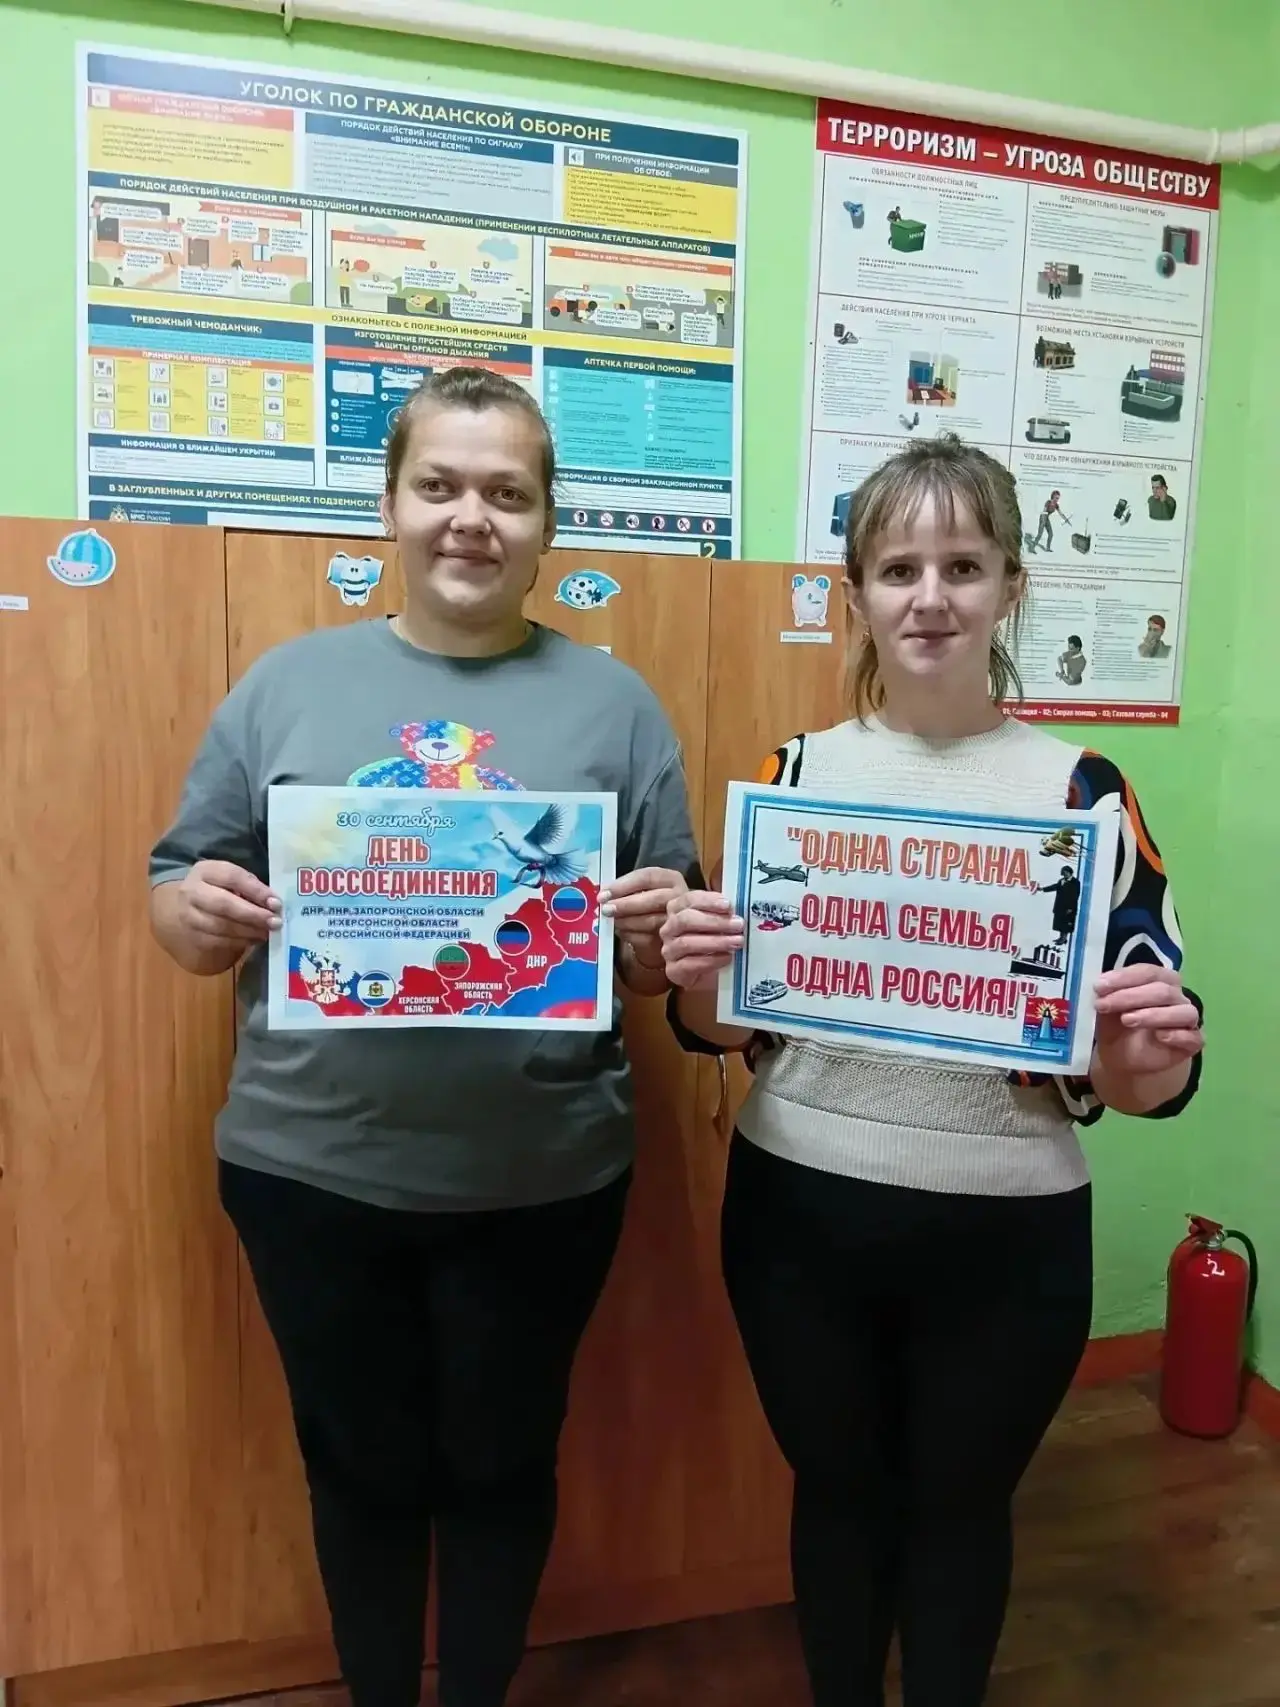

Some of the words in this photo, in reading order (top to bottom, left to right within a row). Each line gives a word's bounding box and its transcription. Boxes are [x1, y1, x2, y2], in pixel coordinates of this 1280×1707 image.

[240, 81, 322, 104] УГОЛОК
[330, 93, 357, 109] ПО
[364, 97, 513, 129] ГРАЖДАНСКОЙ
[520, 117, 611, 142] ОБОРОНЕ
[340, 120, 380, 131] ПОРЯДОК
[382, 125, 424, 137] ДЕЙСТВИЙ
[426, 131, 473, 143] НАСЕЛЕНИЯ
[474, 137, 485, 145] ПО
[487, 138, 523, 150] СИГНАЛУ
[390, 135, 438, 147] «ВНИМАНИЕ
[594, 152, 610, 161] ПРИ
[611, 155, 655, 166] ПОЛУЧЕНИИ
[657, 161, 709, 173] ИНФОРМАЦИИ
[827, 117, 975, 162] ТЕРРОРИЗМ
[1003, 143, 1084, 178] УГРОЗА
[1093, 158, 1209, 198] ОБЩЕСТВУ
[120, 179, 167, 191] ПОРЯДОК
[169, 184, 220, 197] ДЕЙСТВИЙ
[222, 190, 277, 203] НАСЕЛЕНИЯ
[299, 199, 359, 212] ВОЗДУШНОМ
[370, 207, 417, 218] РАКЕТНОМ
[420, 213, 471, 225] НАПАДЕНИИ
[474, 219, 535, 232] (ПРИМЕНЕНИИ
[540, 227, 599, 240] БЕСПИЛОТНЫХ
[601, 234, 658, 247] ЛЕТАТЕЛЬНЫХ
[661, 241, 710, 253] АППАРАТОВ)
[841, 303, 873, 313] ДЕЙСТВИЯ
[130, 314, 191, 327] ТРЕВОЖНЫЙ
[331, 314, 401, 328] ОЗНАКОМЬТЕСЬ
[411, 322, 458, 334] ПОЛЕЗНОЙ
[460, 327, 526, 340] ИНФОРМАЦИЕЙ
[354, 330, 415, 343] ИЗГОТОВЛЕНИЕ
[418, 336, 471, 348] ПРОСТЕЙШИХ
[473, 342, 507, 352] СРЕДСТВ
[141, 351, 187, 361] ПРИМЕРНАЯ
[374, 341, 408, 351] ЗАЩИТЫ
[411, 345, 447, 355] ОРГАНОВ
[450, 349, 489, 359] ДЫХАНИЯ
[583, 357, 621, 367] АПТЕЧКА
[623, 360, 655, 371] ПЕРВОЙ
[120, 439, 177, 449] ИНФОРМАЦИЯ
[239, 448, 275, 457] УКРЫТИИ
[609, 476, 638, 484] СБОРНОМ
[640, 478, 698, 489] ЭВАКУАЦИОННОМ
[108, 483, 114, 491] В
[117, 484, 193, 496] ЗАГЛУБЛЕННЫХ
[204, 489, 242, 500] ДРУГИХ
[244, 492, 310, 503] ПОМЕЩЕНИЯХ
[313, 496, 375, 507] ПОДЗЕМНОГО
[703, 542, 716, 559] 2
[336, 812, 361, 827] 30
[366, 807, 456, 836] сентября
[368, 836, 430, 866] ДЕНЬ
[786, 826, 891, 874] "ОДНА
[899, 836, 1039, 894] СТРАНА,
[298, 868, 498, 899] ВОССОЕДИНЕНИЯ
[354, 906, 433, 916] ЗАПОРОЖСКОЙ
[436, 907, 485, 916] ОБЛАСТИ
[338, 917, 408, 927] ХЕРСОНСКОЙ
[411, 919, 458, 927] ОБЛАСТИ
[799, 893, 889, 940] ОДНА
[897, 903, 1019, 957] СЕМЬЯ,
[318, 930, 327, 938] С
[328, 928, 400, 939] РОССИЙСКОЙ
[404, 928, 471, 940] ФЕДЕРАЦИЕЙ
[568, 932, 589, 945] ЛНР
[526, 954, 548, 969] ДНР
[454, 982, 502, 990] ЗАПОРОЖСКАЯ
[785, 953, 874, 1000] ОДНА
[880, 965, 1037, 1018] РОССИЯ!"
[398, 996, 439, 1004] ХЕРСОНСКАЯ
[463, 991, 493, 999] ОБЛАСТЬ
[404, 1004, 434, 1013] ОБЛАСТЬ
